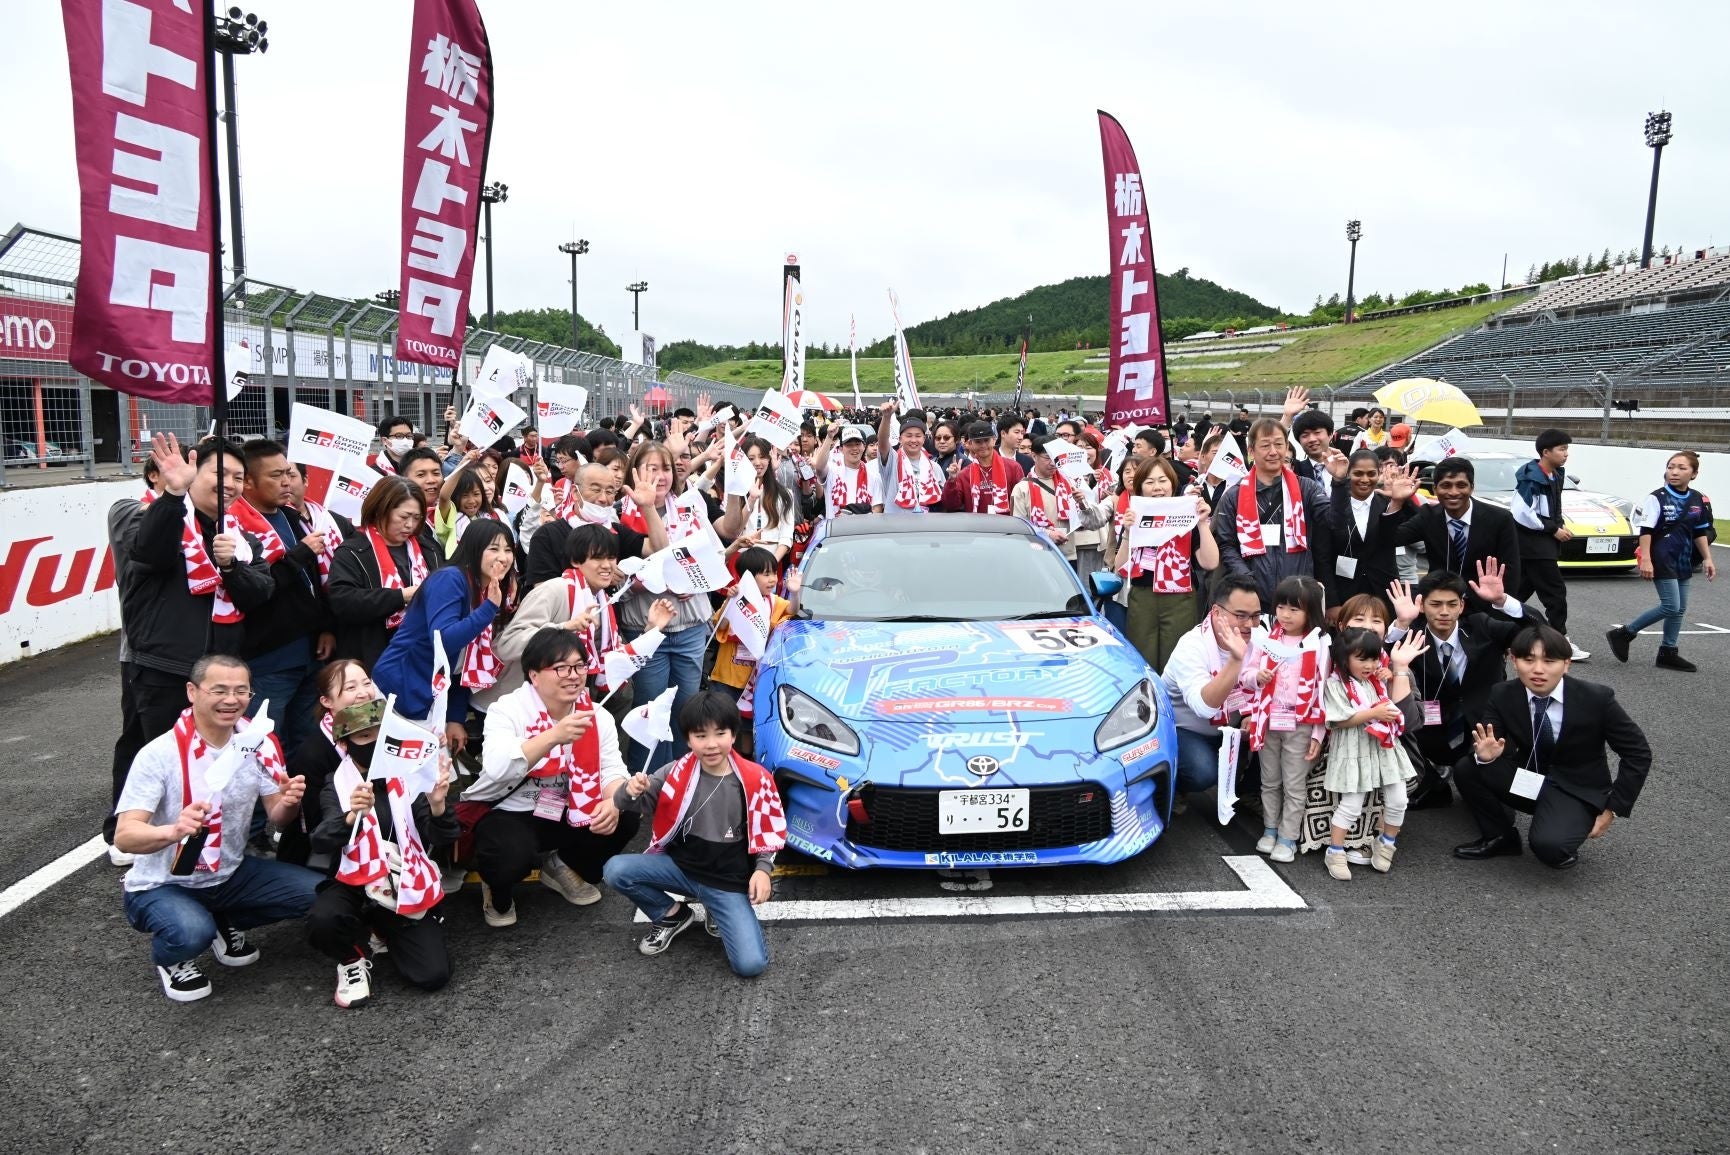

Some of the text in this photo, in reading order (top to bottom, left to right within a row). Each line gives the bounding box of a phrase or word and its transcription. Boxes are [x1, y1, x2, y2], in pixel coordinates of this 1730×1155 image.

[407, 32, 482, 338] 栃木トヨタ
[1114, 173, 1156, 401] 栃木トヨタ
[0, 315, 56, 350] mo
[405, 339, 457, 360] TOYOTA
[96, 351, 212, 386] TOYOTA
[1111, 407, 1161, 421] TOYOTA
[301, 428, 335, 448] GR
[334, 440, 364, 451] GAZOO
[336, 435, 368, 448] TOYOTA
[332, 445, 361, 456] Racing
[336, 475, 364, 497] GR
[1139, 516, 1166, 529] GR
[672, 547, 697, 567] GR
[1607, 543, 1617, 552] 10
[194, 580, 217, 591] TOYOTA
[1026, 628, 1099, 651] 56
[882, 668, 1066, 698] FACTORY
[935, 699, 1036, 709] GR86/BRZ
[1036, 702, 1057, 710] Cup
[384, 735, 424, 760] GR
[919, 732, 1046, 747] TRUST
[946, 807, 1024, 829] り 56
